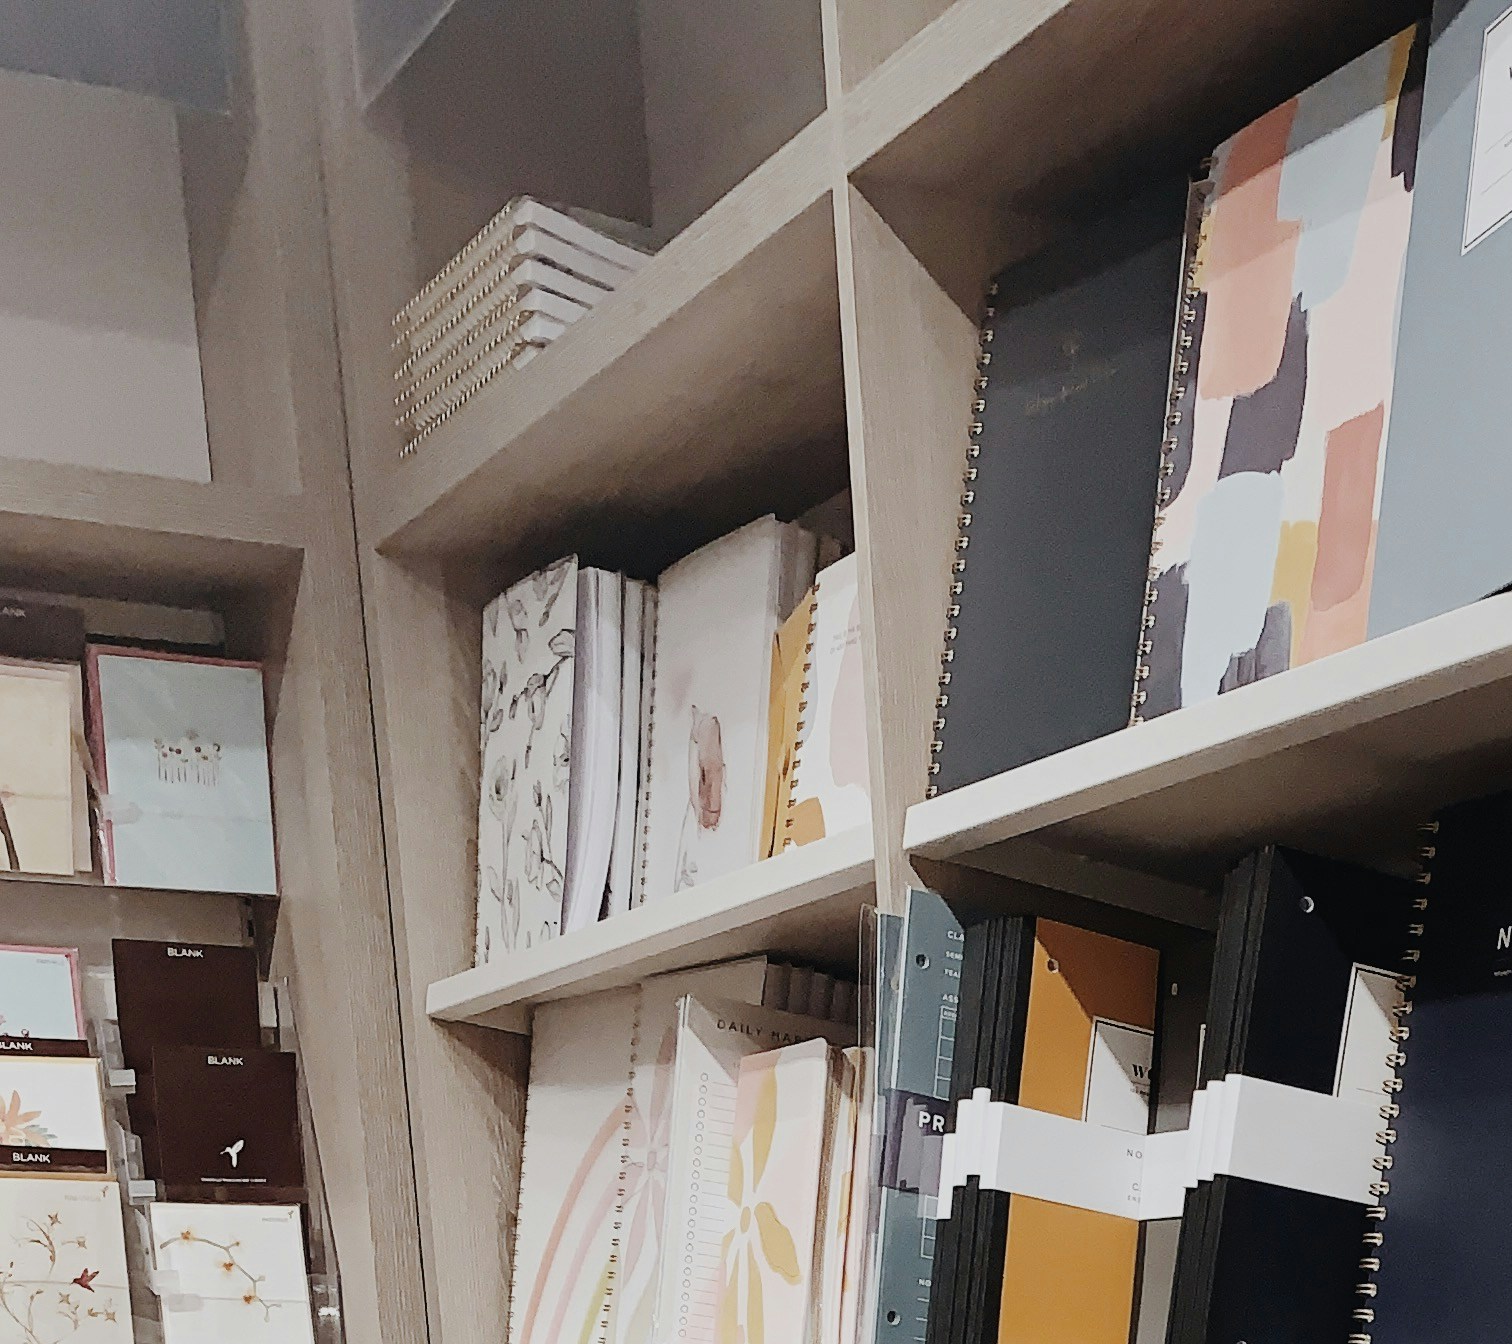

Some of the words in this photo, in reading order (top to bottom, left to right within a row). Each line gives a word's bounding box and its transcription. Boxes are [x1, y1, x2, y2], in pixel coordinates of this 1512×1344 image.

[167, 947, 203, 958] BLANK
[717, 1018, 762, 1037] DAILY
[208, 1056, 243, 1066] BLANK
[13, 1152, 50, 1163] BLANK
